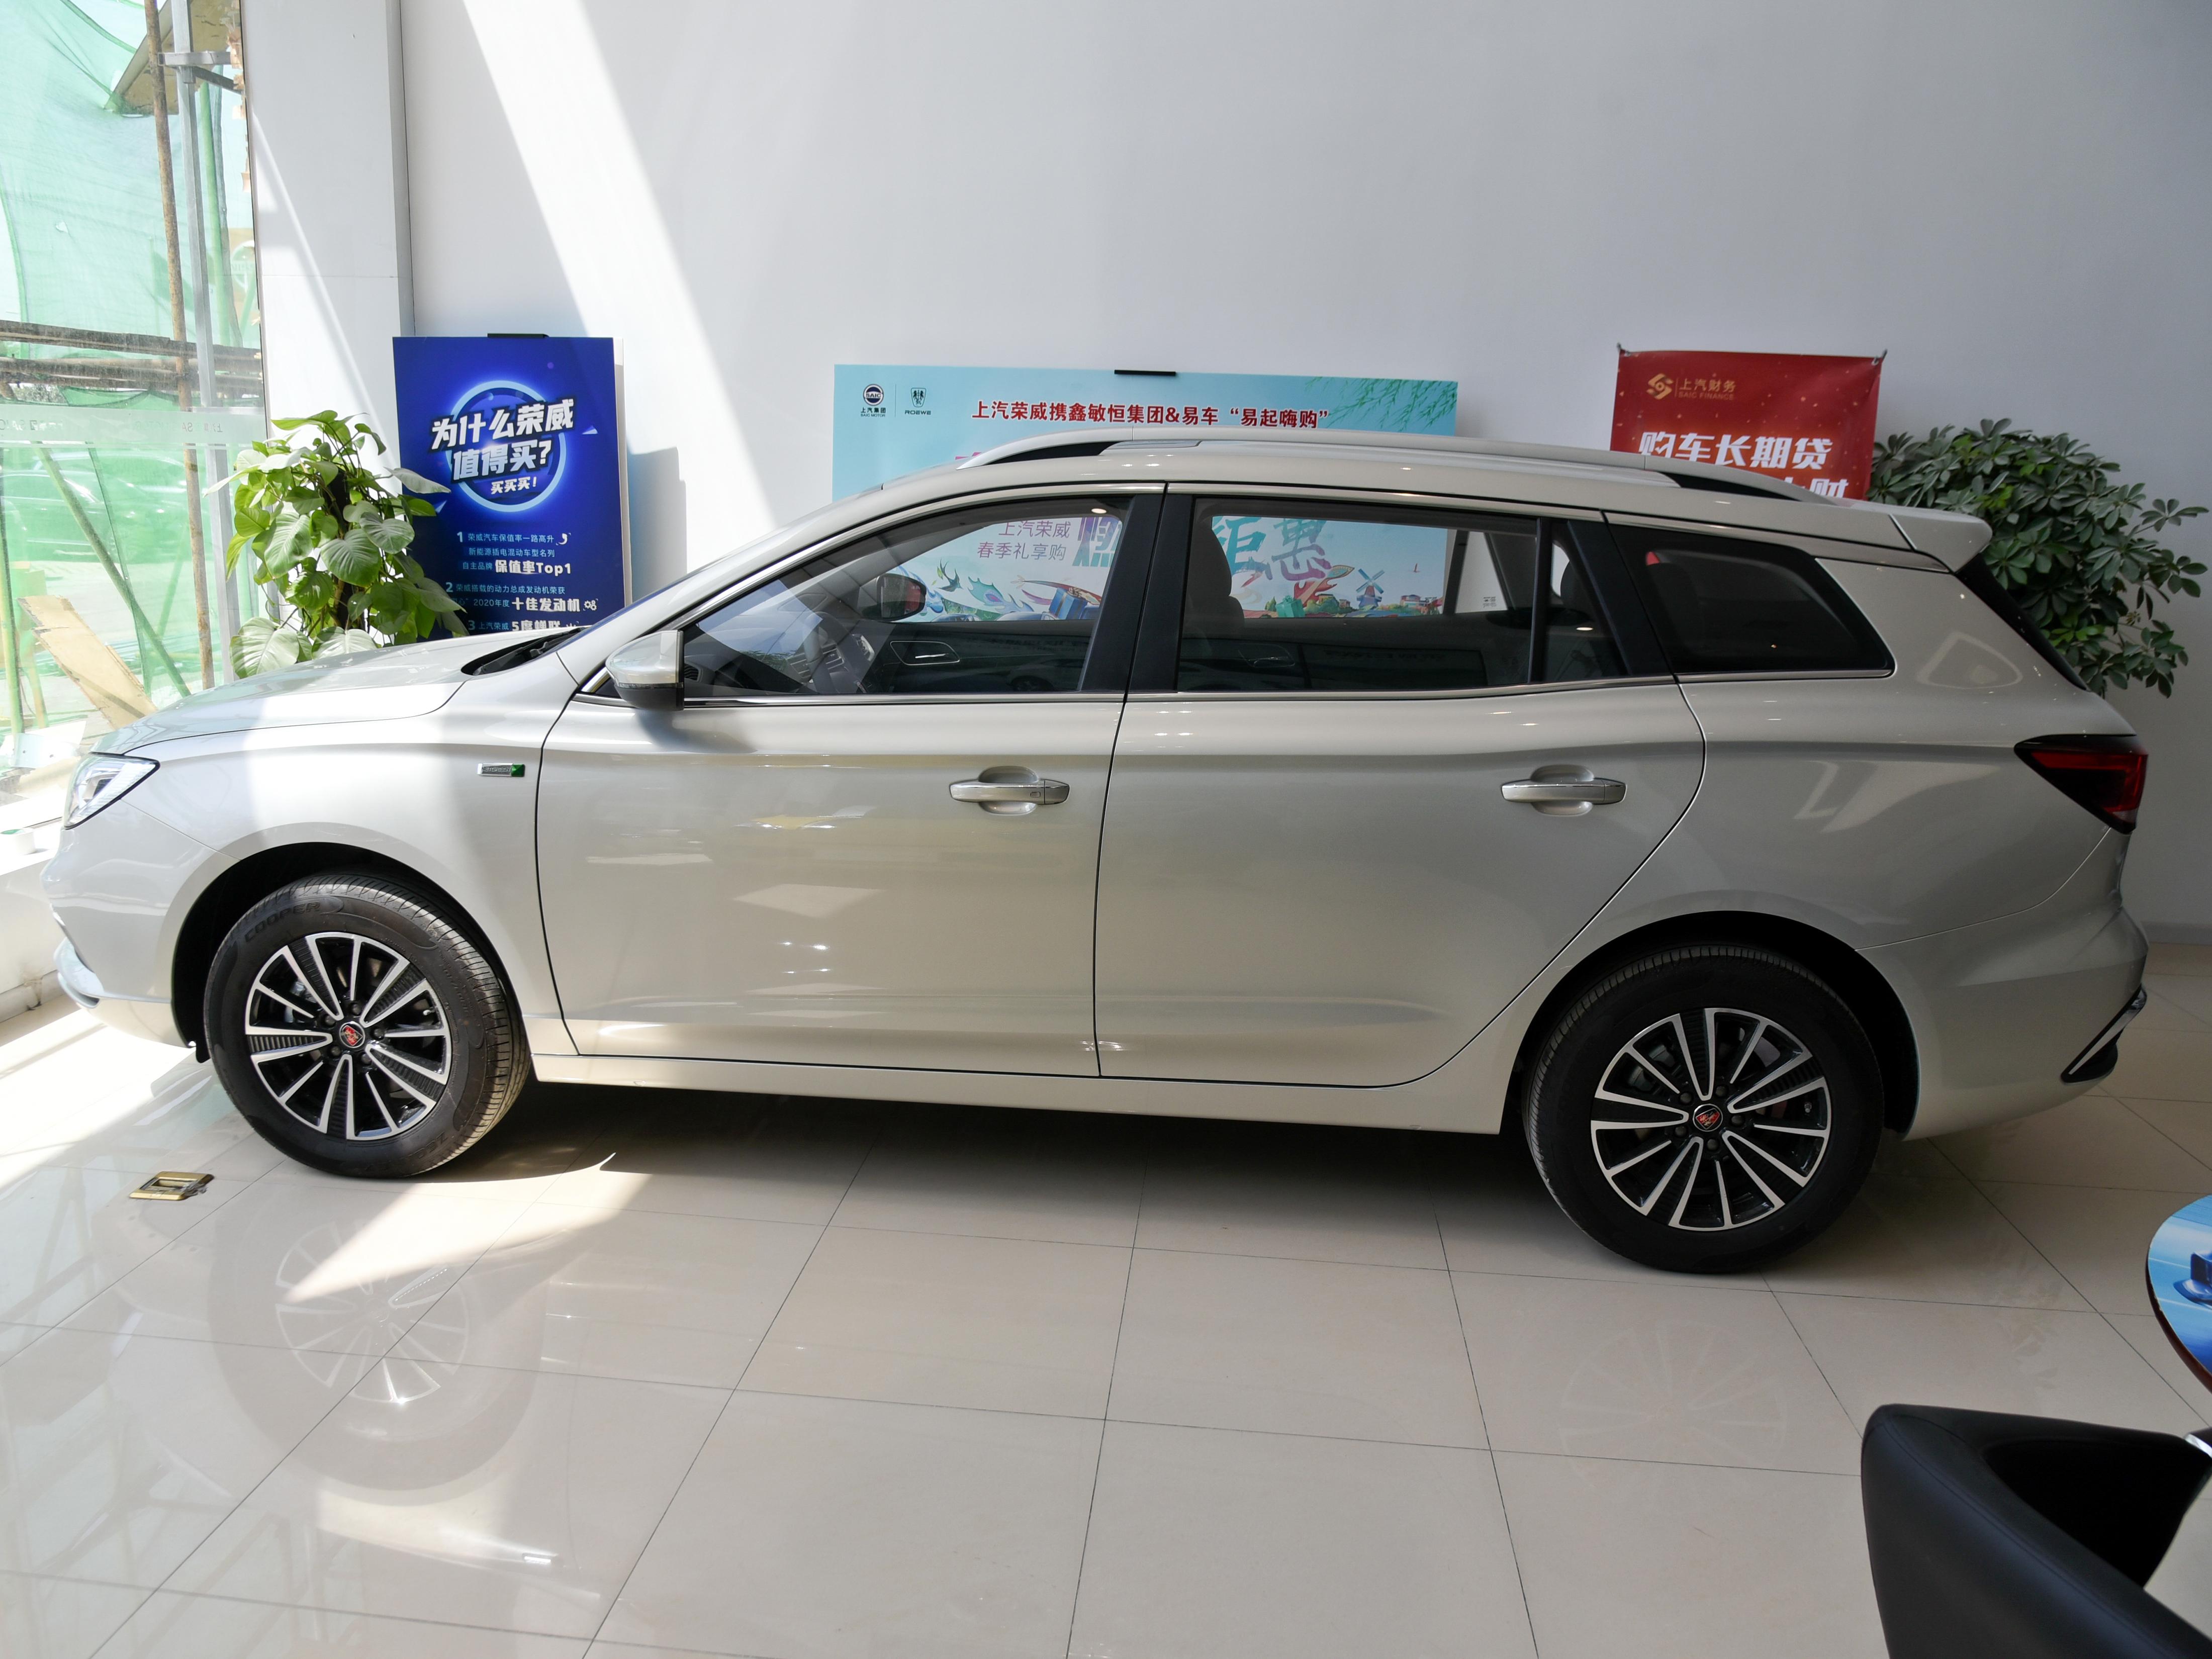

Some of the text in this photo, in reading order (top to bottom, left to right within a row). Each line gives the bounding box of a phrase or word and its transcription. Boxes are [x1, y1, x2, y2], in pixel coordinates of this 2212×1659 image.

[1679, 378, 1736, 393] 上汽财务
[1699, 392, 1734, 401] FINANCE
[431, 398, 574, 450] 为什么荣威
[1638, 431, 1833, 470] 购车长期贷
[453, 439, 552, 481] 值得买?
[491, 477, 537, 495] 买买买!
[998, 520, 1071, 538] 上汽荣威
[457, 532, 554, 543] 1 荣威汽车保值率一路高升
[469, 547, 555, 558] 新能源插电混动车型名列
[977, 541, 1067, 561] 春季礼享购
[463, 560, 572, 577] 自主品牌 保值率Top1
[455, 583, 566, 595] 荣威搭载的动力总成发动机荣获
[473, 599, 510, 608] 2020年度
[512, 597, 581, 612] 十佳发动机
[479, 621, 509, 630] 上汽荣威
